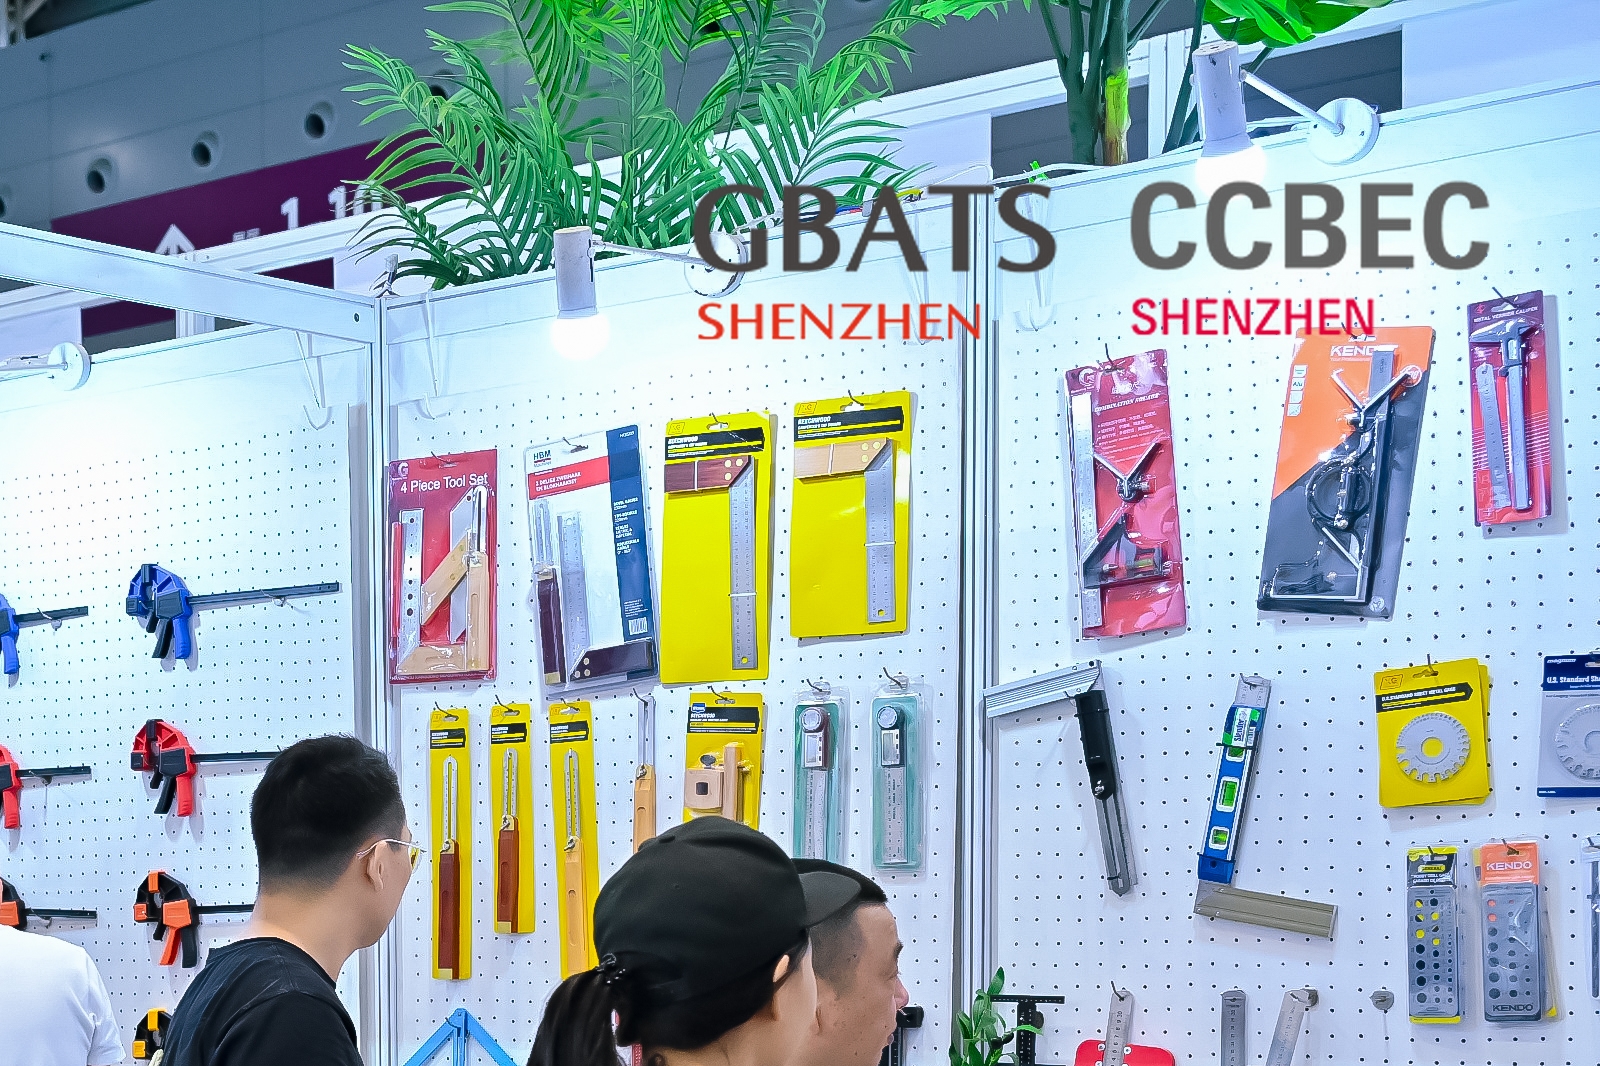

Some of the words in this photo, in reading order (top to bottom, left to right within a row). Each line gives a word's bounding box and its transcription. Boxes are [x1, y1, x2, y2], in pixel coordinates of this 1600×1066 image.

[533, 449, 552, 461] HBM
[400, 481, 408, 494] 4
[410, 479, 441, 493] Piece
[443, 474, 466, 489] Tool
[469, 472, 488, 486] Set
[1560, 675, 1590, 683] Standard
[1486, 861, 1533, 871] KENDO
[1492, 1003, 1534, 1012] KENDO
